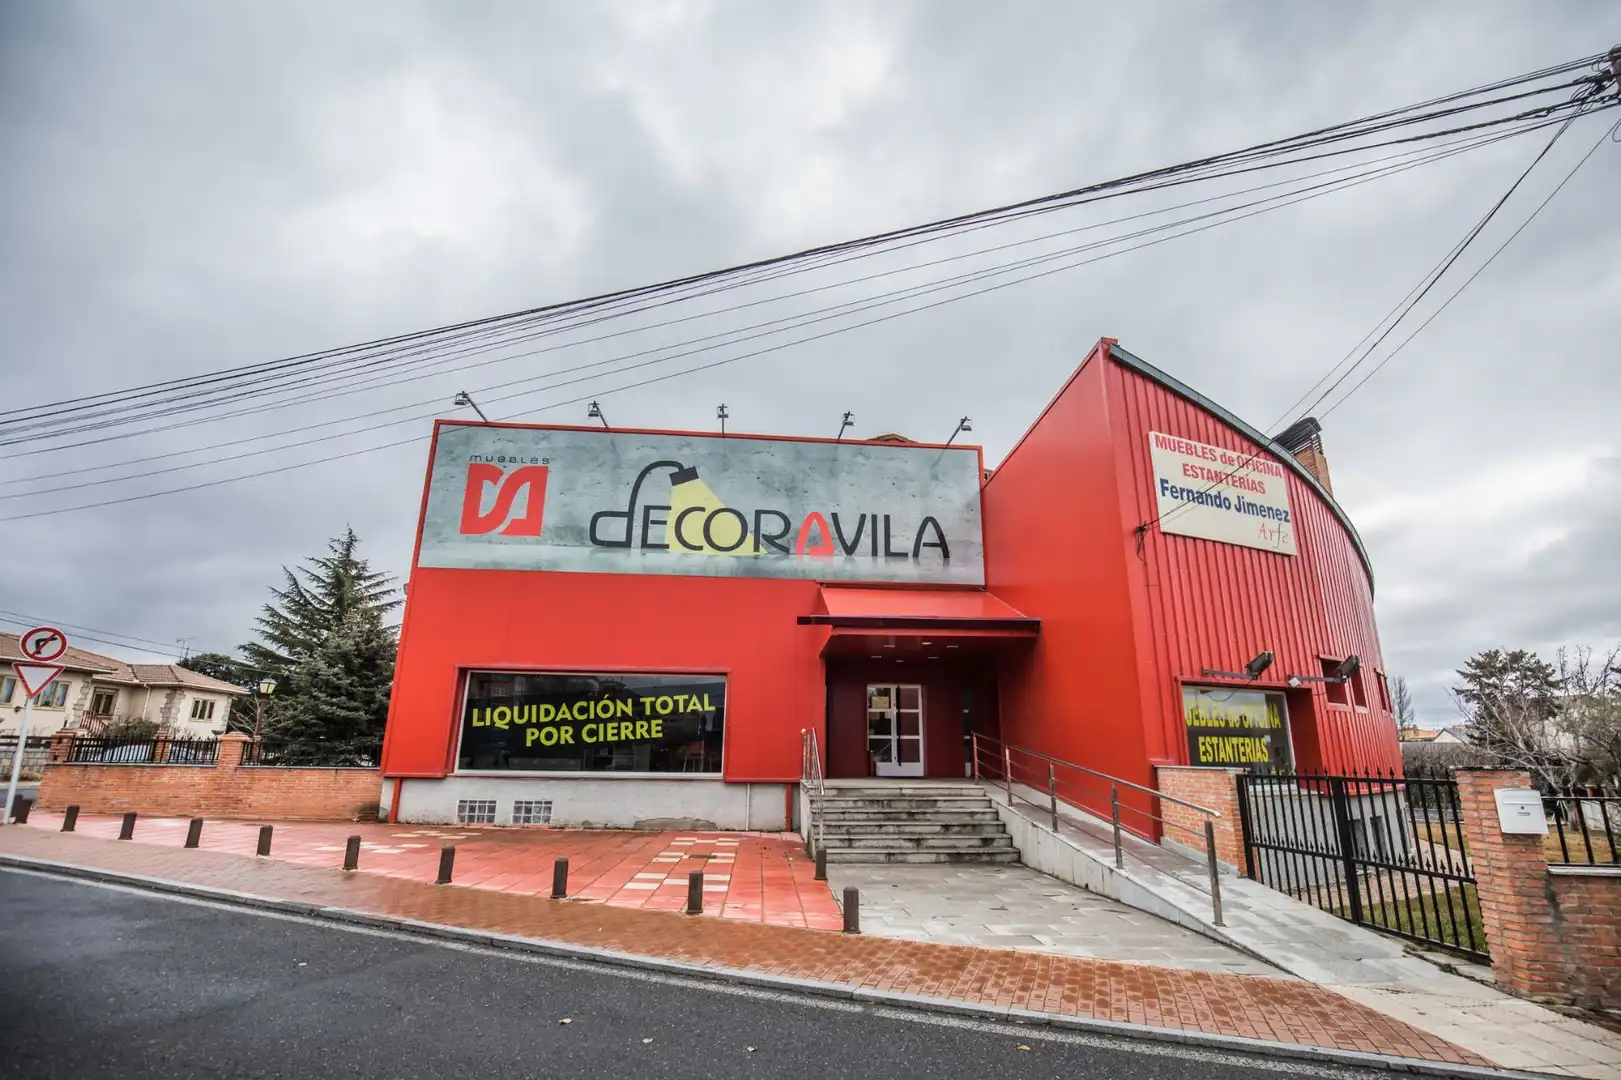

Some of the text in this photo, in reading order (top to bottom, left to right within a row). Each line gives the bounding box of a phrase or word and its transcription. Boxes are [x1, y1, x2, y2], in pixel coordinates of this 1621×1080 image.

[1154, 434, 1283, 479] MUEBLES de OFICINA
[1159, 477, 1291, 523] Fernando Jimenez
[472, 693, 716, 730] LIQUIDACIÓN TOTAL
[525, 719, 664, 748] POR CIERRE
[1198, 736, 1269, 763] ESTANTERIAS
